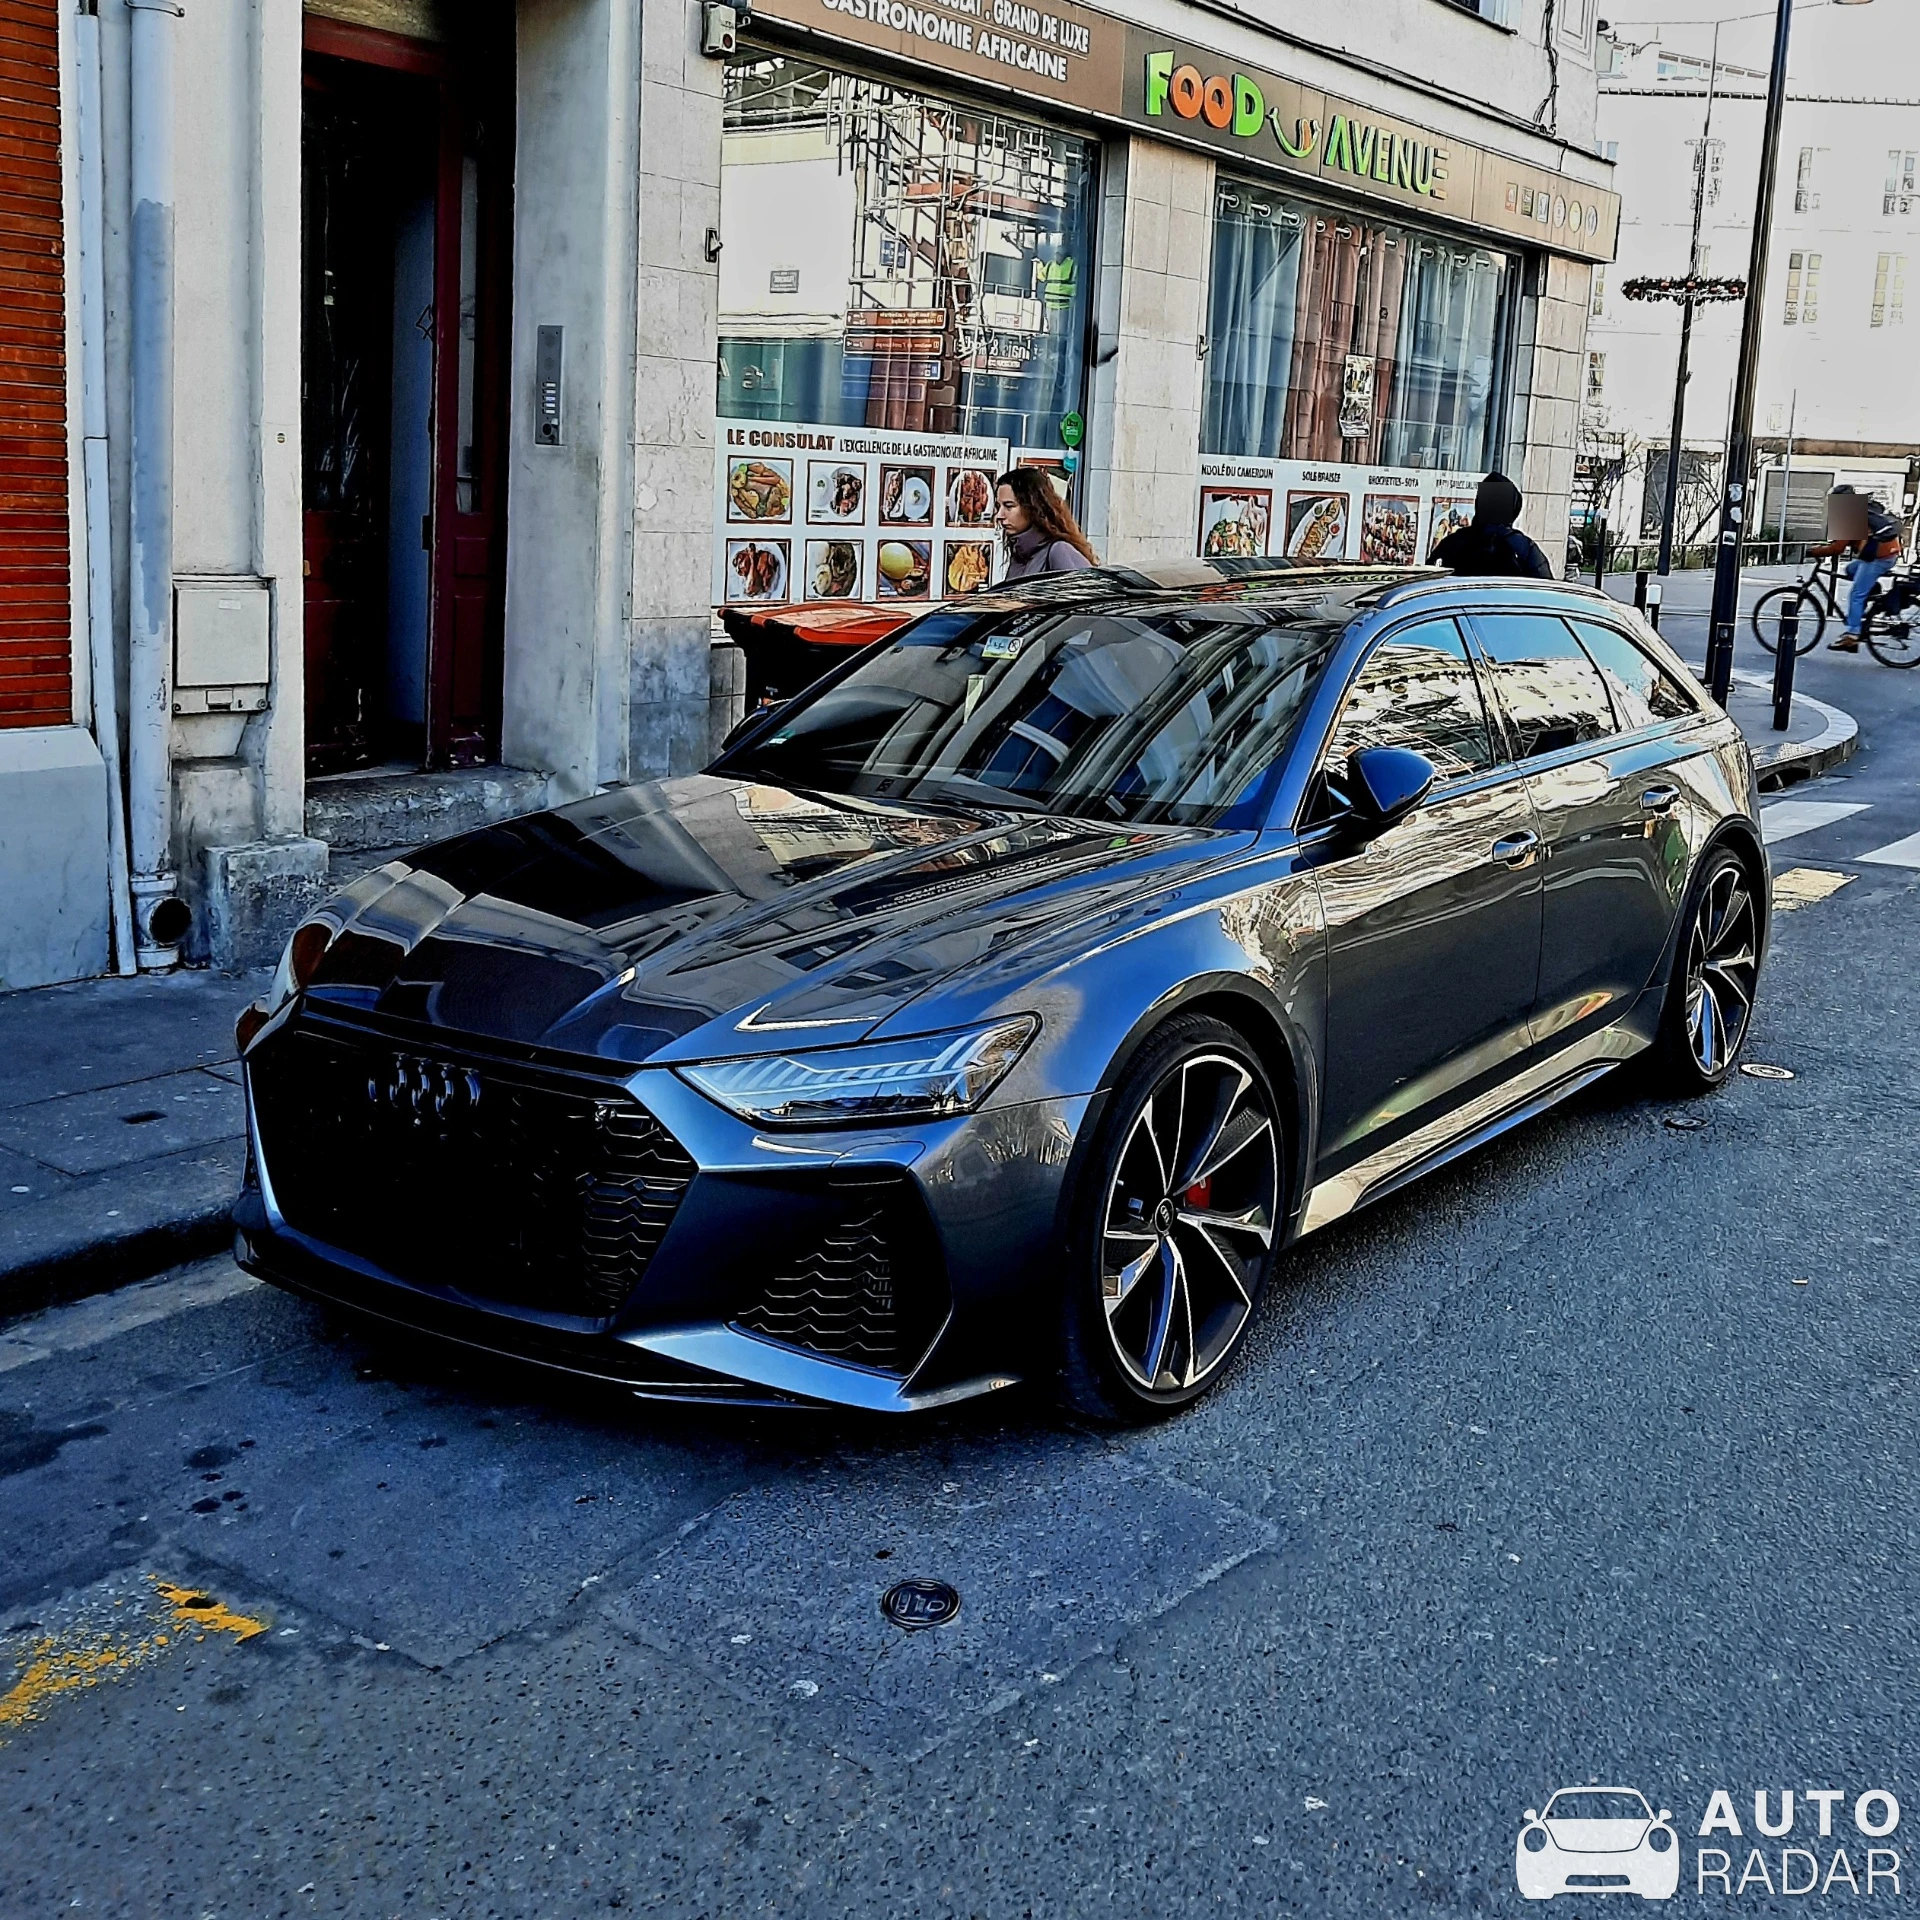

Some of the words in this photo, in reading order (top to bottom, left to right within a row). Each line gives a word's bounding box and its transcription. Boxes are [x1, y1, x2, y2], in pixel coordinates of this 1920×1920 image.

[993, 0, 1040, 37] GRAND
[1041, 13, 1059, 43] DE
[1060, 19, 1090, 54] LUXE
[976, 30, 1068, 82] AFRICAINE
[1144, 50, 1266, 138] FOOD
[1323, 114, 1450, 200] AVENUE
[727, 428, 746, 446] LE
[749, 430, 836, 451] CONSULAT
[840, 439, 890, 455] L'EXCELLENCE
[892, 442, 902, 456] DE
[903, 443, 912, 456] LA
